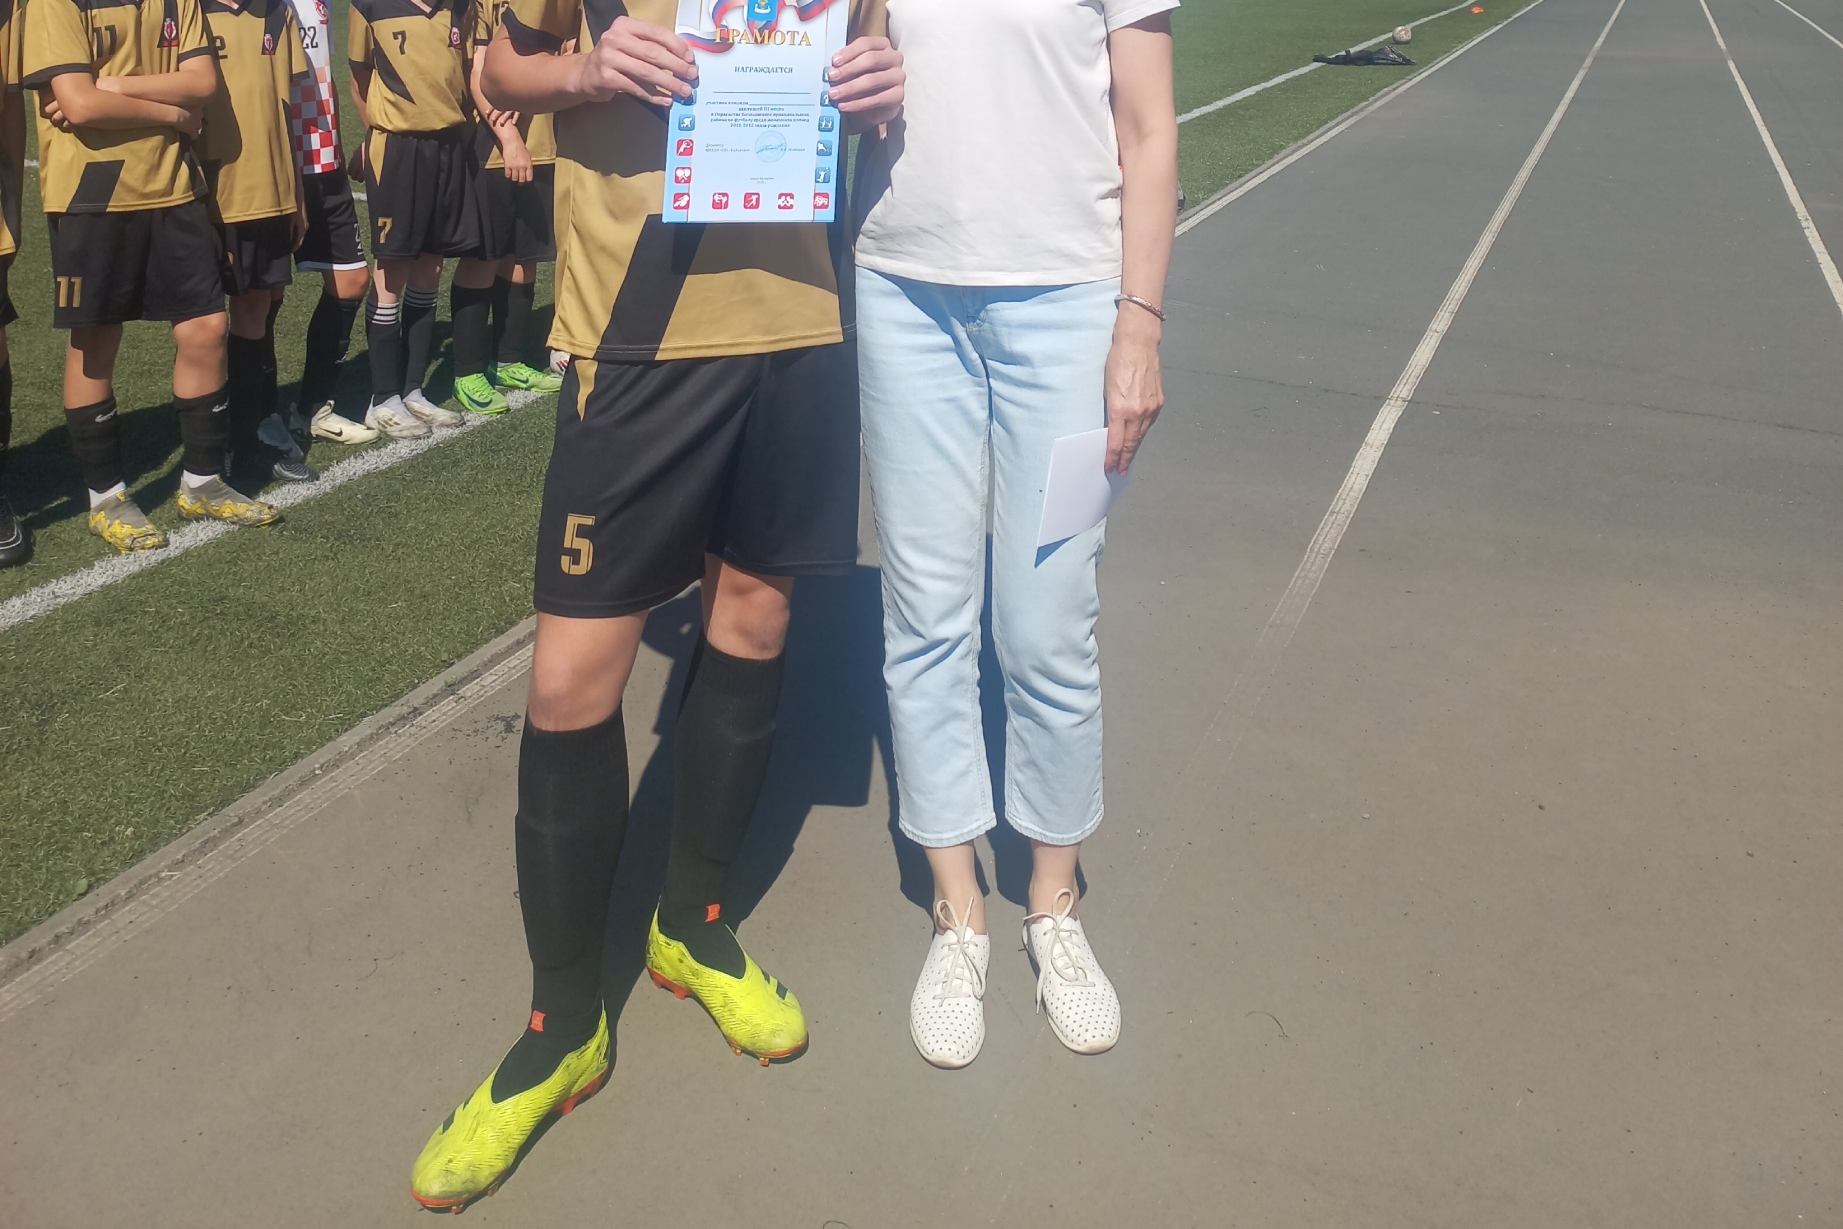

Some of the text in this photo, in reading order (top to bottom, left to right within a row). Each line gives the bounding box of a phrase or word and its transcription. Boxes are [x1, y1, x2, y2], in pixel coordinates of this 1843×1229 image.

[92, 24, 117, 58] 11
[299, 26, 319, 50] 22
[392, 30, 407, 55] 7
[714, 27, 812, 47] ГРАМОТА
[734, 66, 793, 74] НАГРАЖДАЕТСЯ
[377, 217, 393, 244] 7
[56, 276, 83, 308] 11
[561, 513, 596, 575] 5
